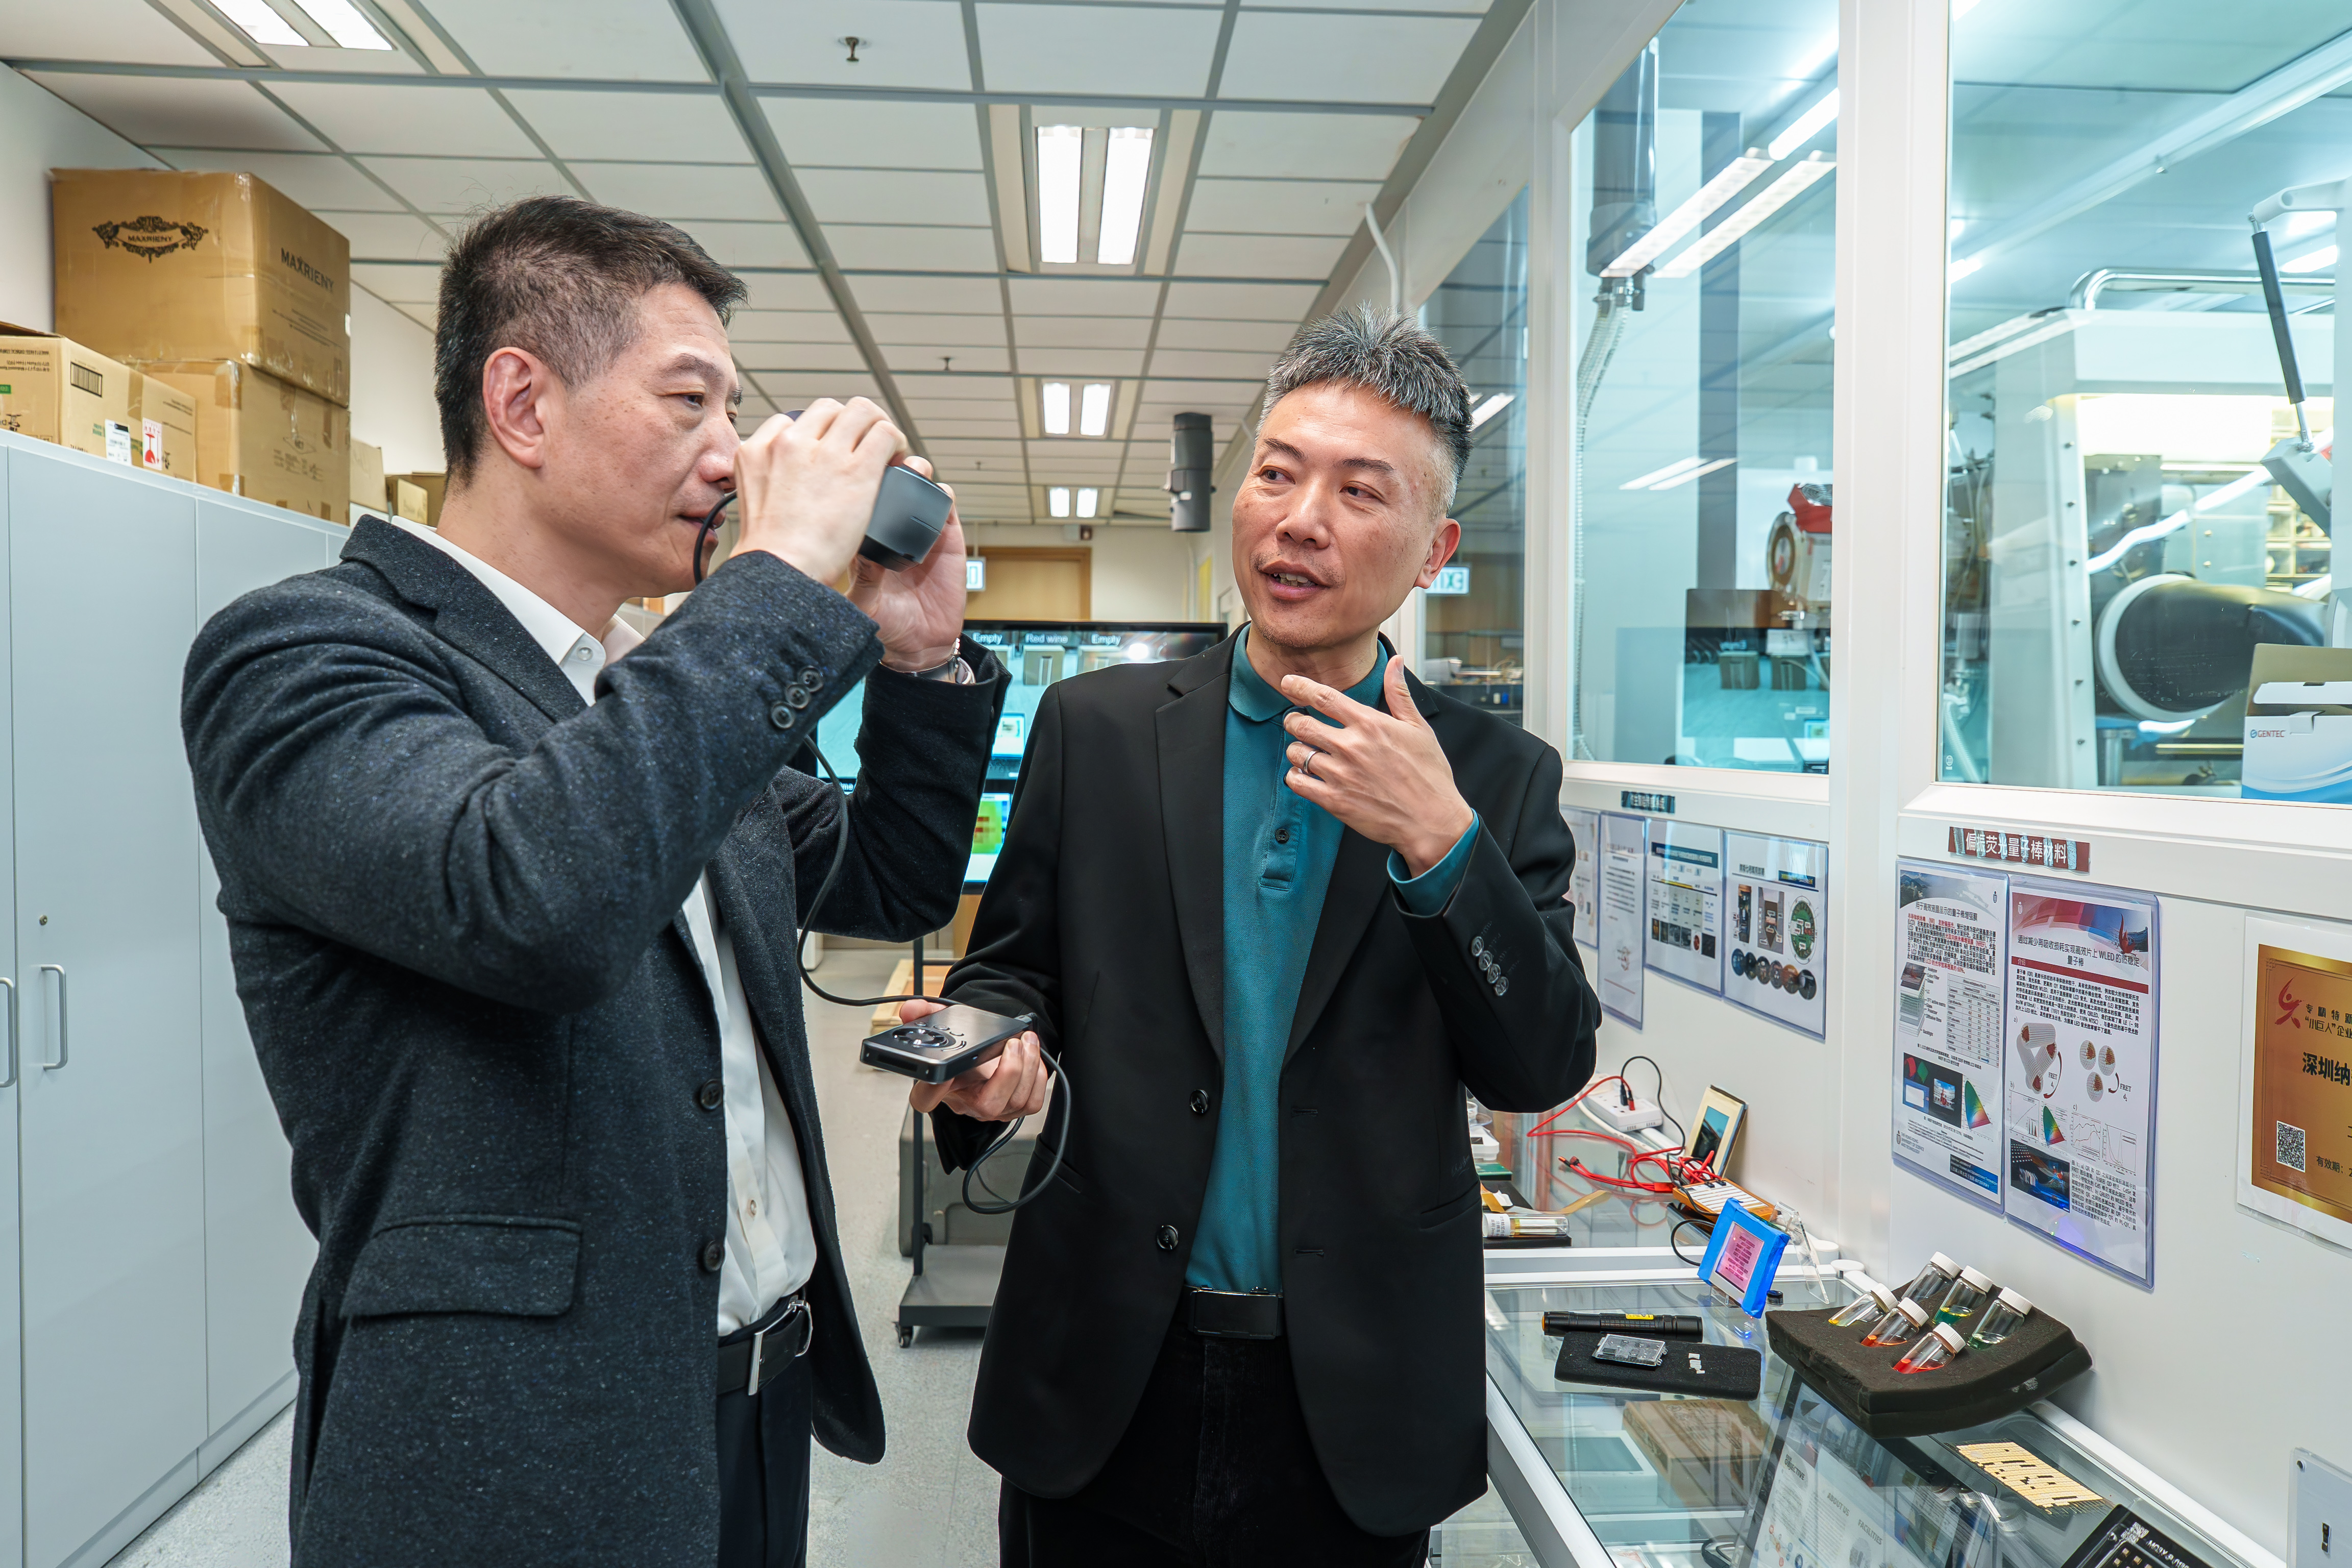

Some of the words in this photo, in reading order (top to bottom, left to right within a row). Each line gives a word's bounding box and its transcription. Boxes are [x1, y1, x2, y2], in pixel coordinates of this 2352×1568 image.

[281, 248, 335, 293] MAXRIENY
[972, 632, 1002, 645] Empty
[1025, 633, 1045, 643] Red
[1046, 633, 1069, 643] wine
[1091, 634, 1121, 646] Empty
[1966, 832, 2067, 864] 偏振荧光量子棒材料
[2018, 935, 2097, 959] 通过减少再吸收损耗实现高效片上
[2099, 950, 2115, 961] WLED
[2116, 953, 2140, 967] 的热稳定
[2067, 955, 2084, 967] 量子棒
[2048, 1072, 2057, 1080] FRET
[2302, 1052, 2352, 1086] 深圳纳
[2010, 1081, 2015, 1090] b)
[2120, 1083, 2132, 1092] FRET
[1784, 1458, 1805, 1481] OBJECTIVE
[1827, 1492, 1843, 1510] ABOUT
[1843, 1505, 1850, 1516] US
[1858, 1519, 1883, 1545] FACILITIES
